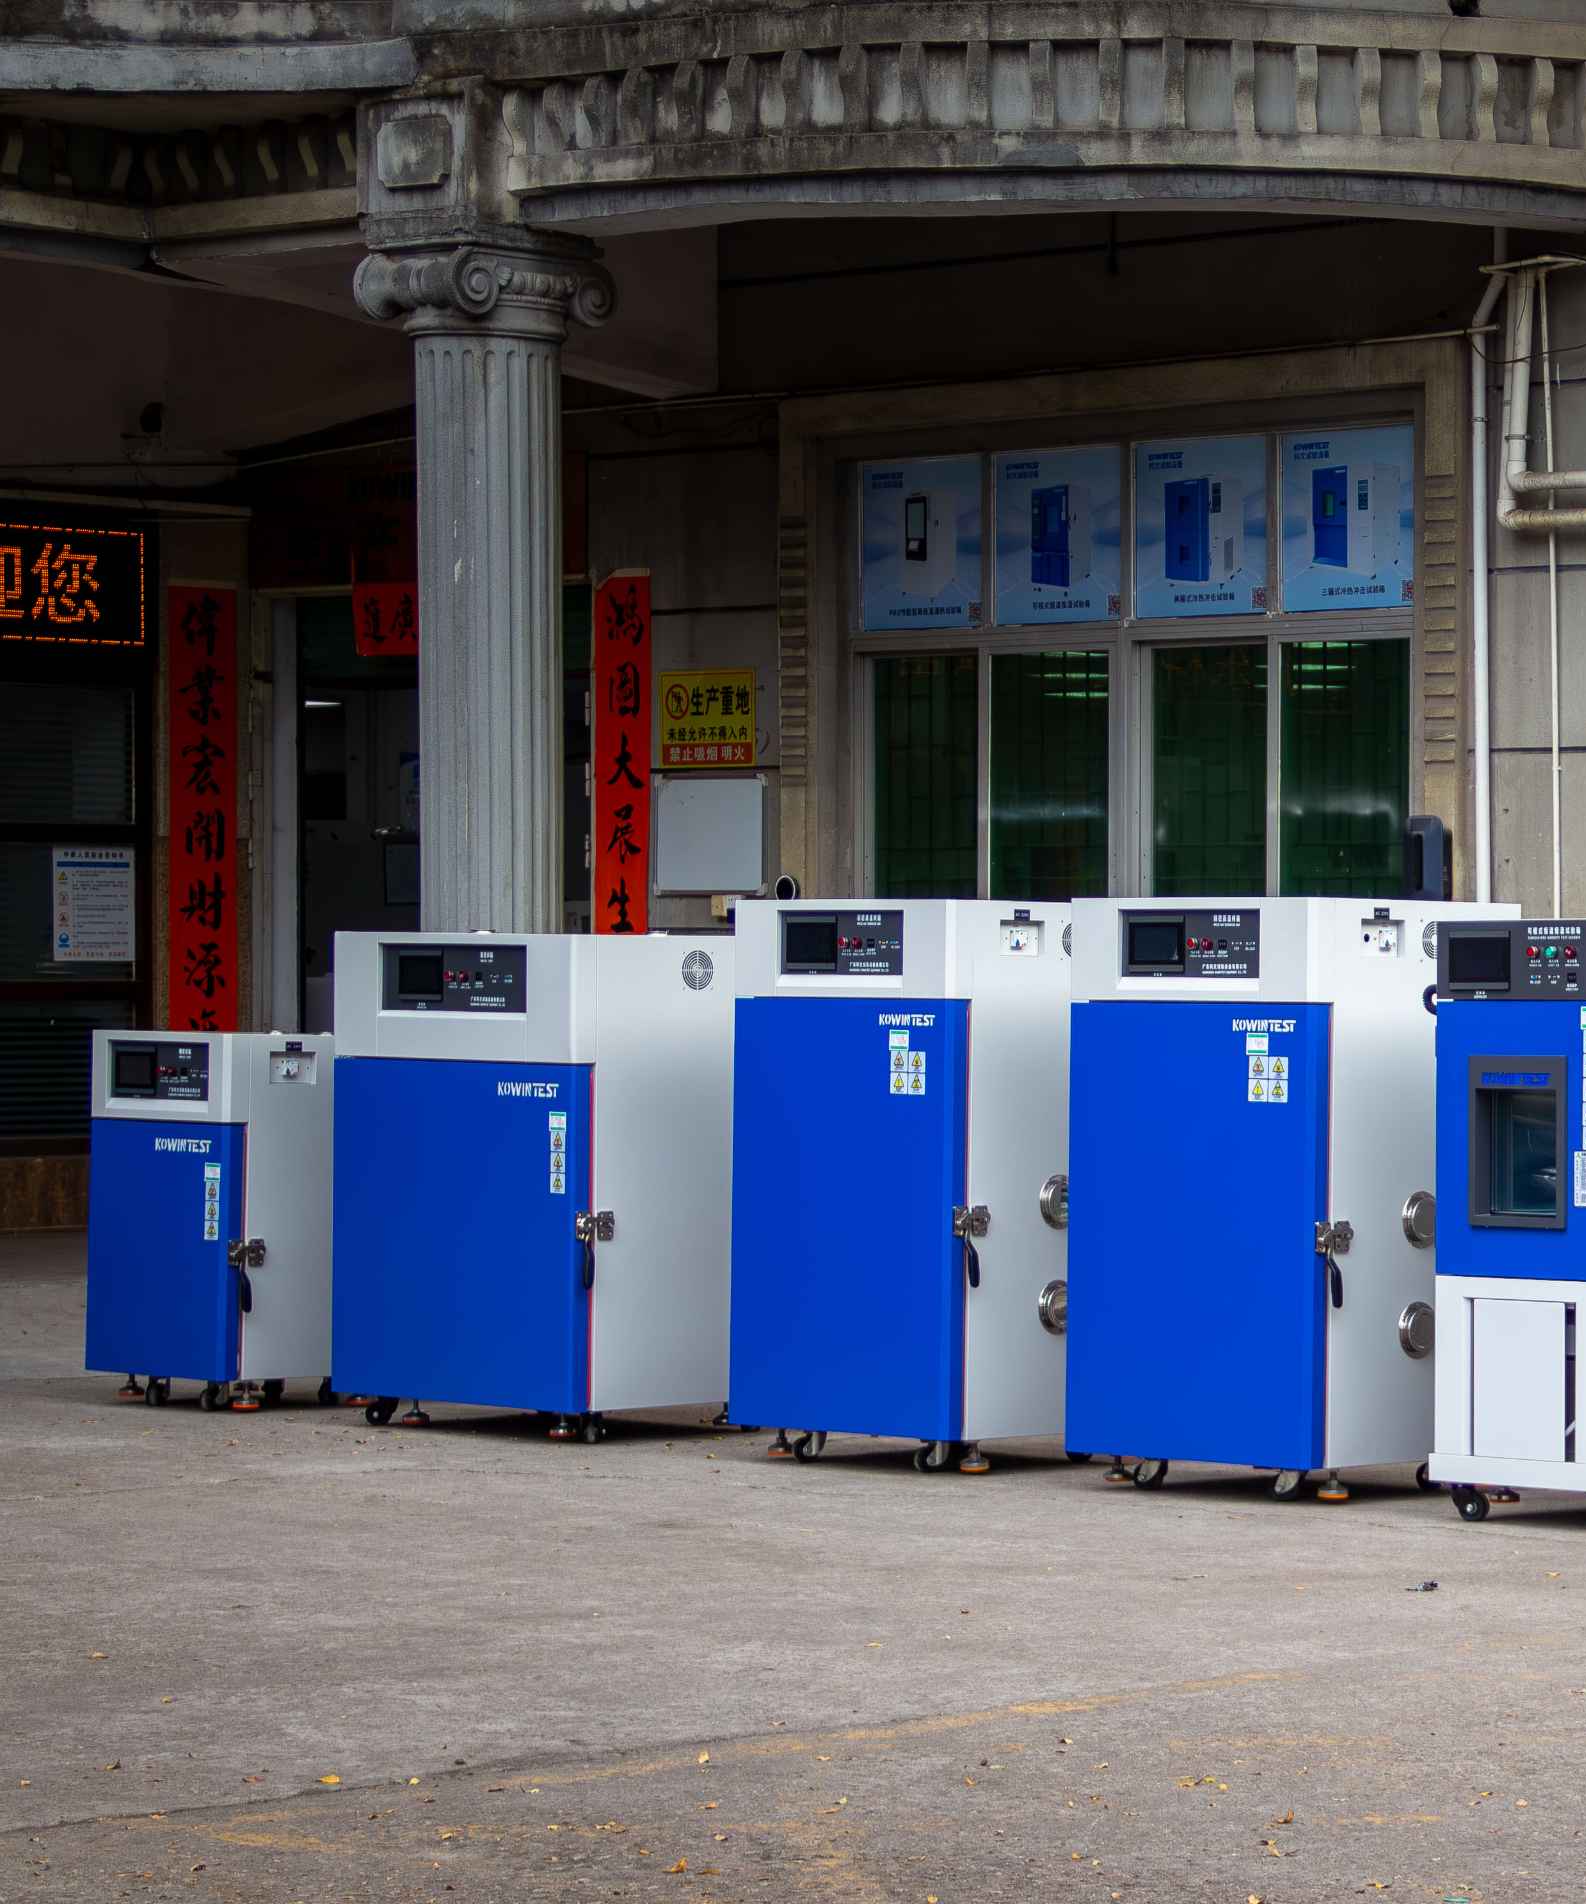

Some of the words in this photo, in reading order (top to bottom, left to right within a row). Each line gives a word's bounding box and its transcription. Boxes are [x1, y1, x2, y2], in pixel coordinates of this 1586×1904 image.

[691, 685, 750, 716] 生产重地
[667, 725, 747, 741] 未经允许不得入内
[878, 1013, 936, 1027] KOWINTEST
[1232, 1019, 1297, 1033] KOWINTEST
[497, 1081, 560, 1098] KOWINTEST
[154, 1137, 212, 1153] KOWINTEST
